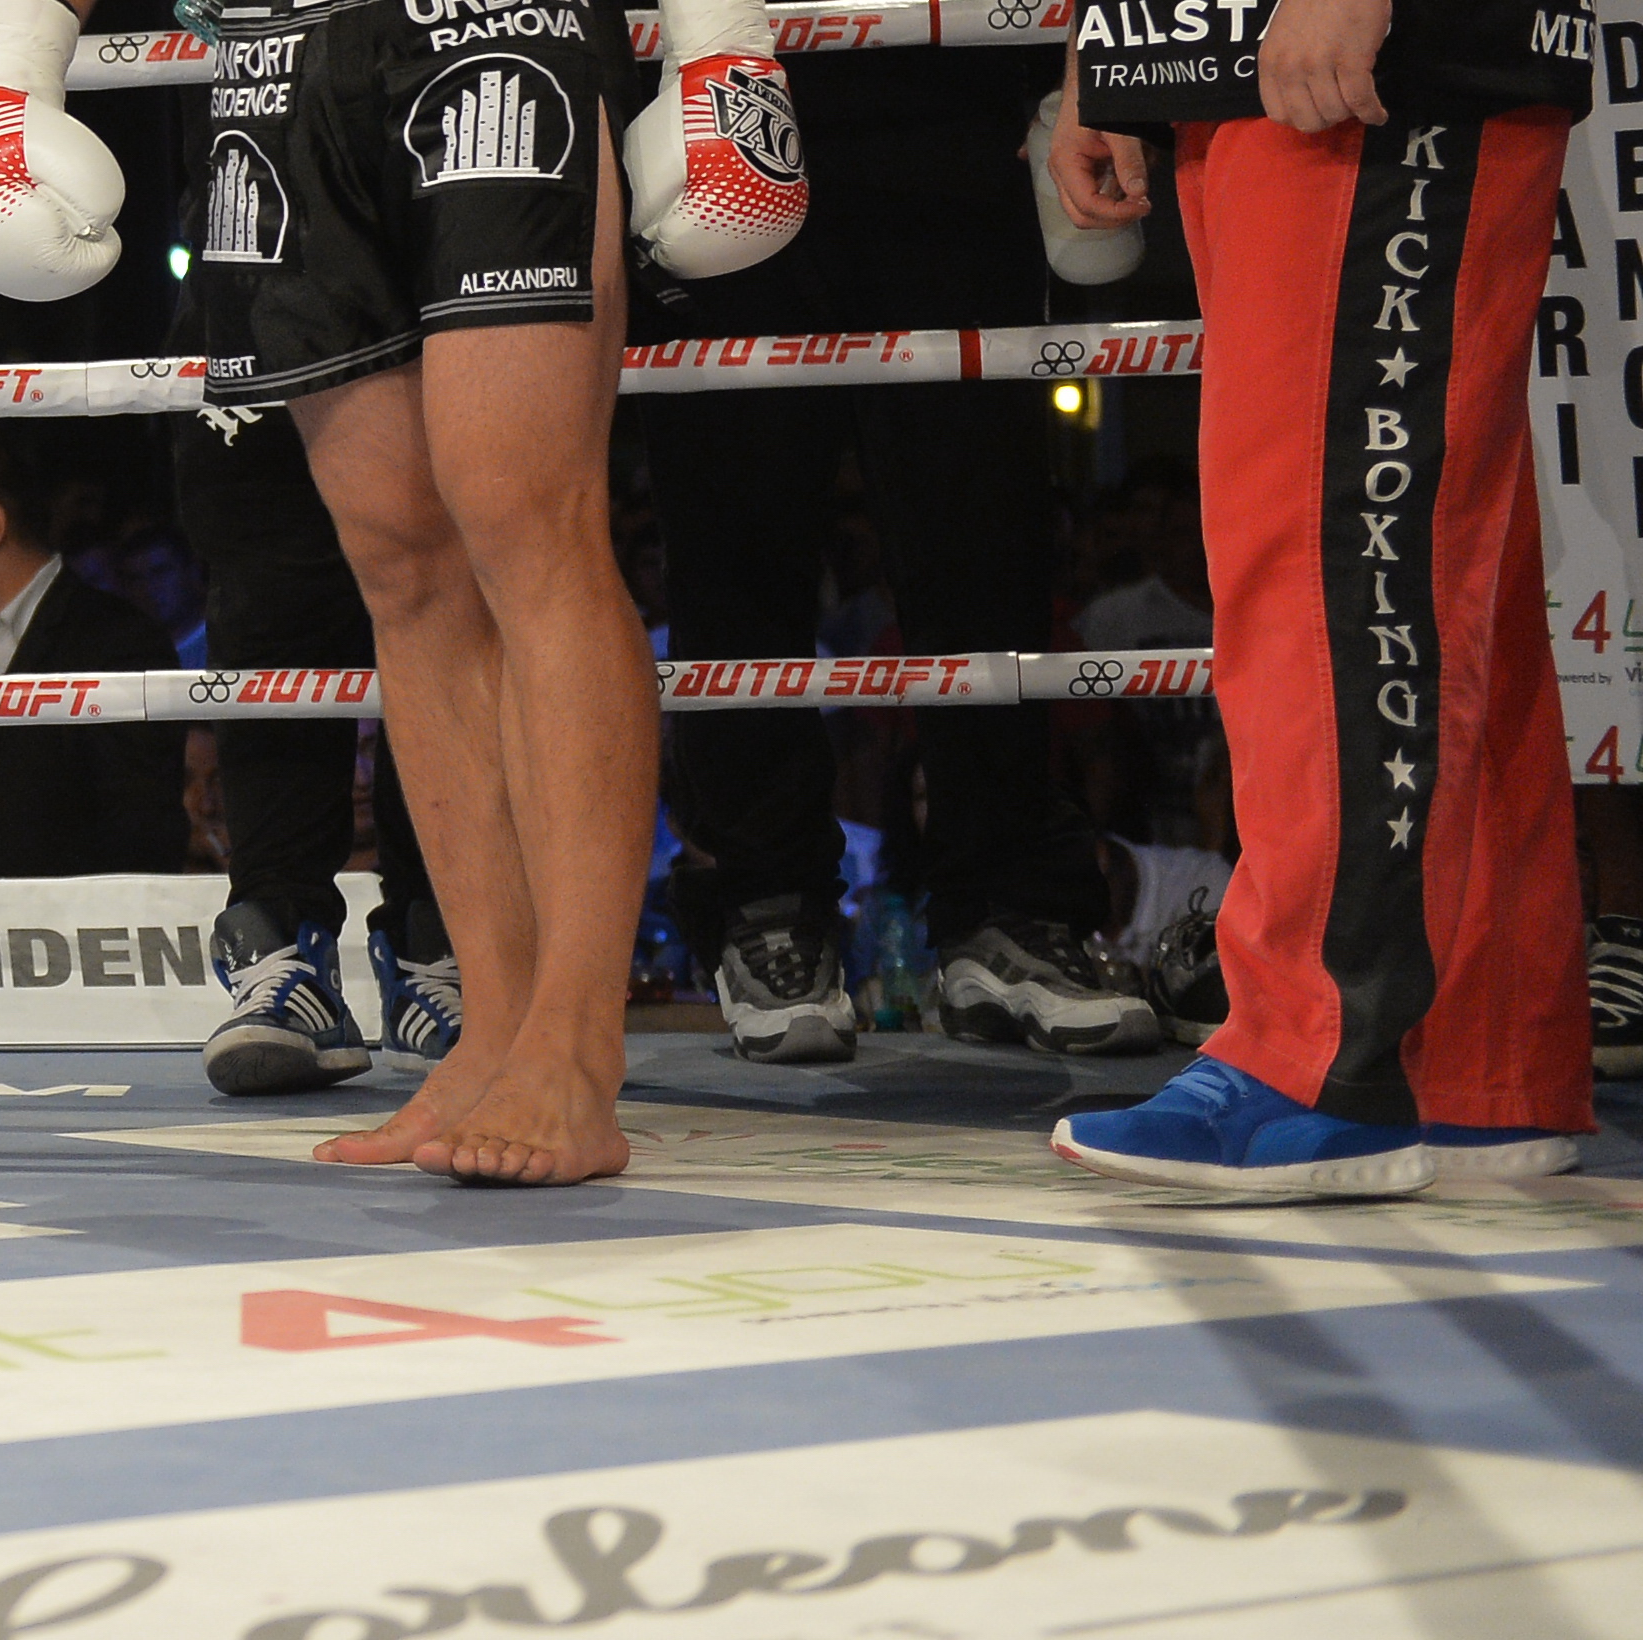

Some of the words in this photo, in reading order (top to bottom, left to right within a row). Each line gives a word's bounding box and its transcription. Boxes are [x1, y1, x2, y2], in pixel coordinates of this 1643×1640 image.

[428, 8, 587, 52] RAHOVA
[1090, 56, 1218, 88] TRAINING
[1373, 125, 1447, 332] KICK
[460, 265, 578, 295] ALEXANDRU
[1360, 406, 1419, 728] BOXING
